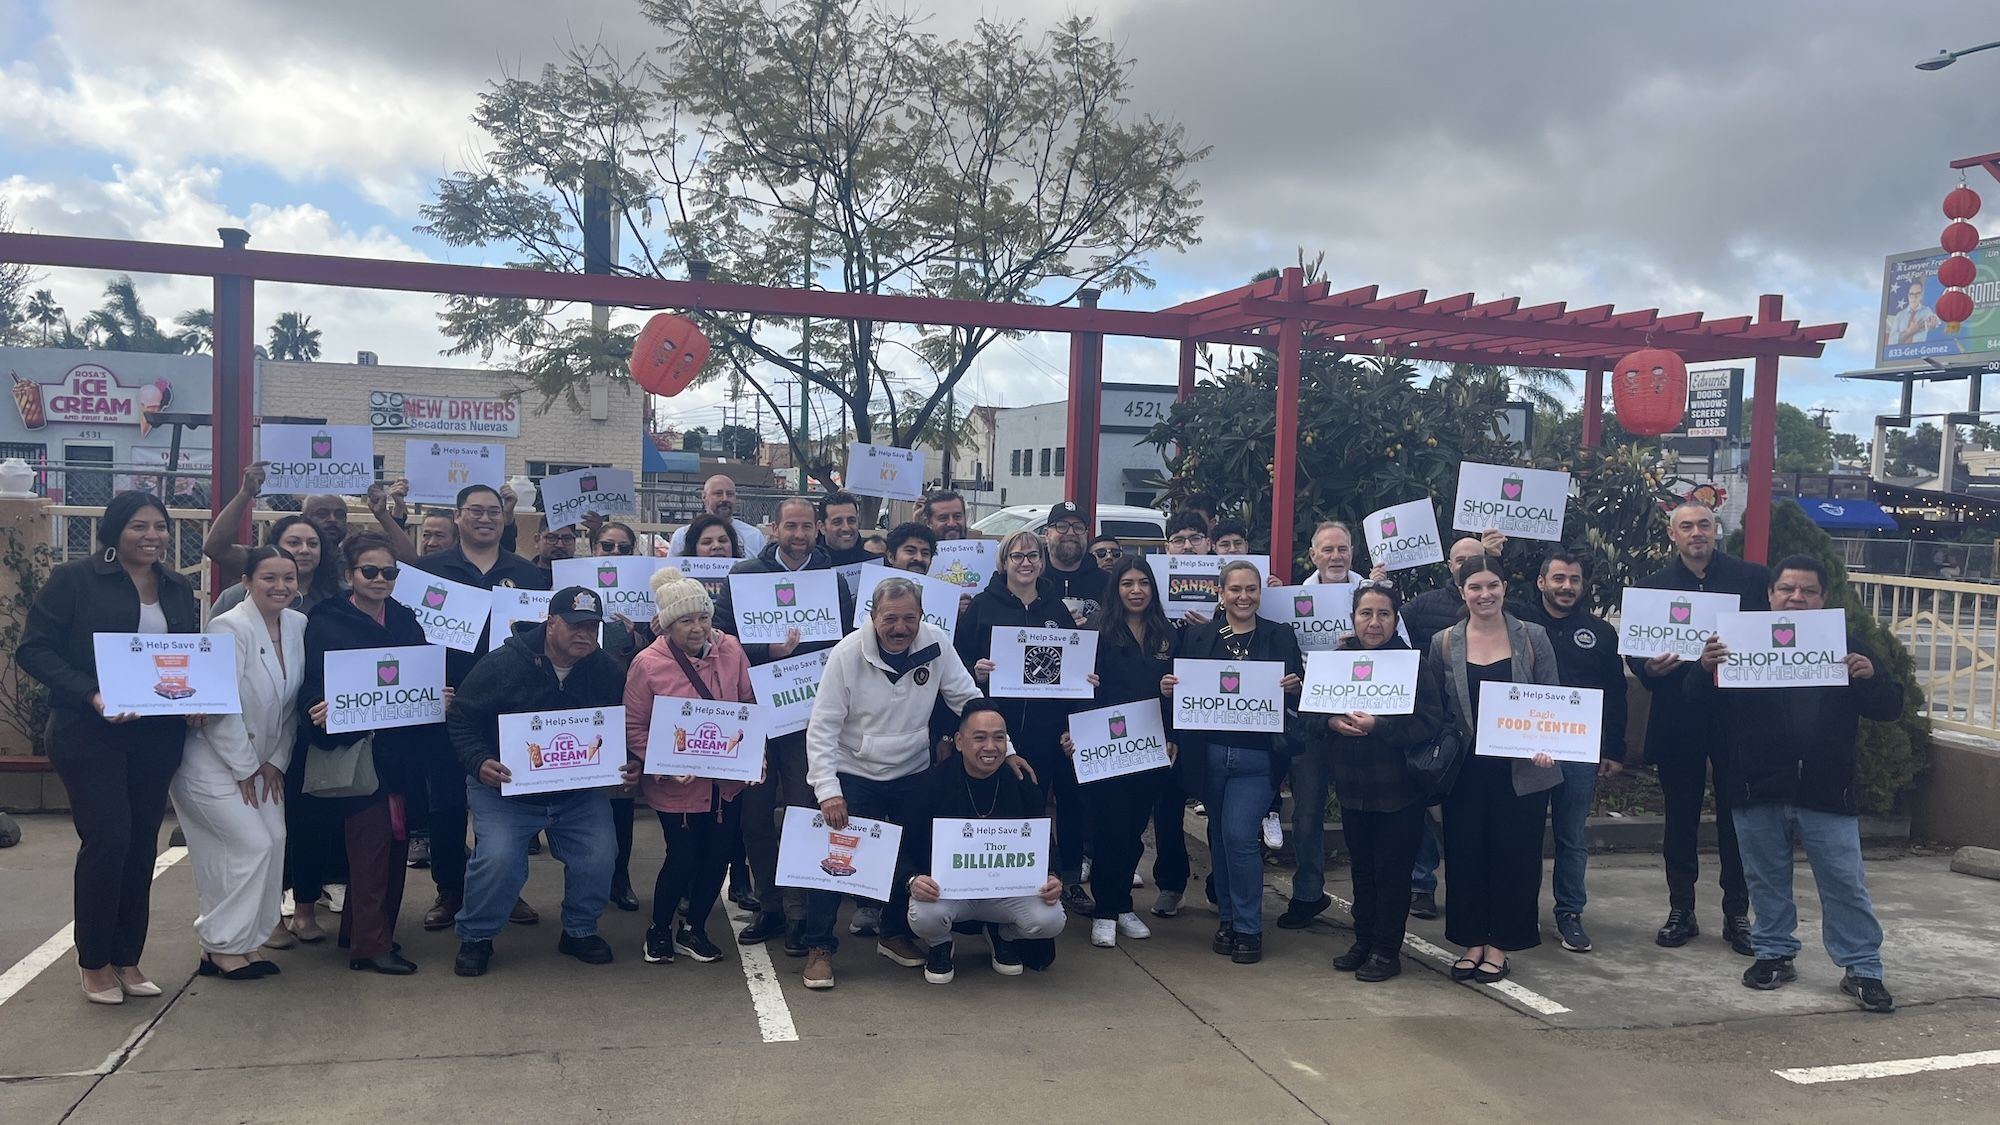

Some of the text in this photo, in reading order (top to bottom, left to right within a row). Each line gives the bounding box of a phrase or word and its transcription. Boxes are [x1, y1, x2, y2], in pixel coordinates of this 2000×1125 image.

[1888, 345, 1948, 358] 833-Get-Gomez
[73, 378, 107, 396] ICE
[1696, 390, 1722, 399] DOORS
[50, 396, 131, 415] CREAM
[403, 400, 516, 421] NEW DRYERS
[1124, 400, 1161, 418] 4521
[1690, 399, 1728, 409] WINDOWS
[1691, 409, 1726, 419] SCREENS
[411, 419, 508, 432] Secadoras Nuevas
[1695, 418, 1720, 428] GLASS
[79, 431, 101, 439] 4531
[443, 447, 460, 455] Help
[270, 462, 370, 475] SHOP LOCAL
[266, 474, 371, 489] CITY HEIGHTS
[552, 493, 632, 515] SHOP LOCAL
[1463, 499, 1558, 522] SHOP LOCAL
[1459, 512, 1559, 535] CITY HEIGHTS
[1371, 534, 1436, 557] OP LOCAL
[1180, 560, 1196, 568] Help
[532, 596, 550, 604] Help
[606, 591, 655, 604] LOCAL
[604, 603, 657, 617] EIGHTS
[743, 608, 836, 625] SHOP LOCAL
[423, 611, 475, 634] LOCAL
[741, 621, 839, 638] CITY HGHTS
[922, 613, 951, 632] CAL
[1303, 619, 1352, 633] LOCAL
[423, 626, 475, 646] IGHTS
[1048, 634, 1067, 642] Save
[1298, 632, 1338, 646] HEIGH
[1628, 624, 1711, 643] SHOP LOC
[146, 641, 195, 650] Help Save
[1623, 637, 1705, 655] CITY HEIG
[1727, 650, 1842, 667] SHOP LOCAL
[783, 660, 817, 673] Help Save
[1723, 665, 1845, 681] CITY HEIGHTS
[793, 676, 813, 686] Thor
[772, 682, 820, 708] BILLIA
[1311, 684, 1410, 697] SHOP LOCAL
[1523, 691, 1566, 701] Help Save
[336, 687, 440, 710] SHOP LOCAL
[1182, 696, 1279, 712] SHOP LOCAL
[1304, 696, 1411, 709] CITY HEIGHTS
[331, 702, 442, 726] CITY HEIGHTS
[695, 706, 735, 717] Help Save
[1178, 709, 1280, 726] CITY HEIGHTS
[1529, 708, 1556, 720] Eagle
[545, 716, 590, 727] Help Save
[1496, 717, 1587, 735] FOOD CENTER
[699, 729, 717, 740] ICE
[555, 740, 574, 751] ICE
[687, 739, 728, 751] CREAM
[1080, 736, 1162, 762] SHOP LOCAL
[543, 750, 587, 763] CREAM
[1079, 749, 1167, 776] CITY HEIGHTS
[847, 824, 868, 833] Save
[976, 826, 1018, 836] Help Save
[984, 842, 1008, 851] Thor
[952, 852, 1036, 869] BILLIARDS
